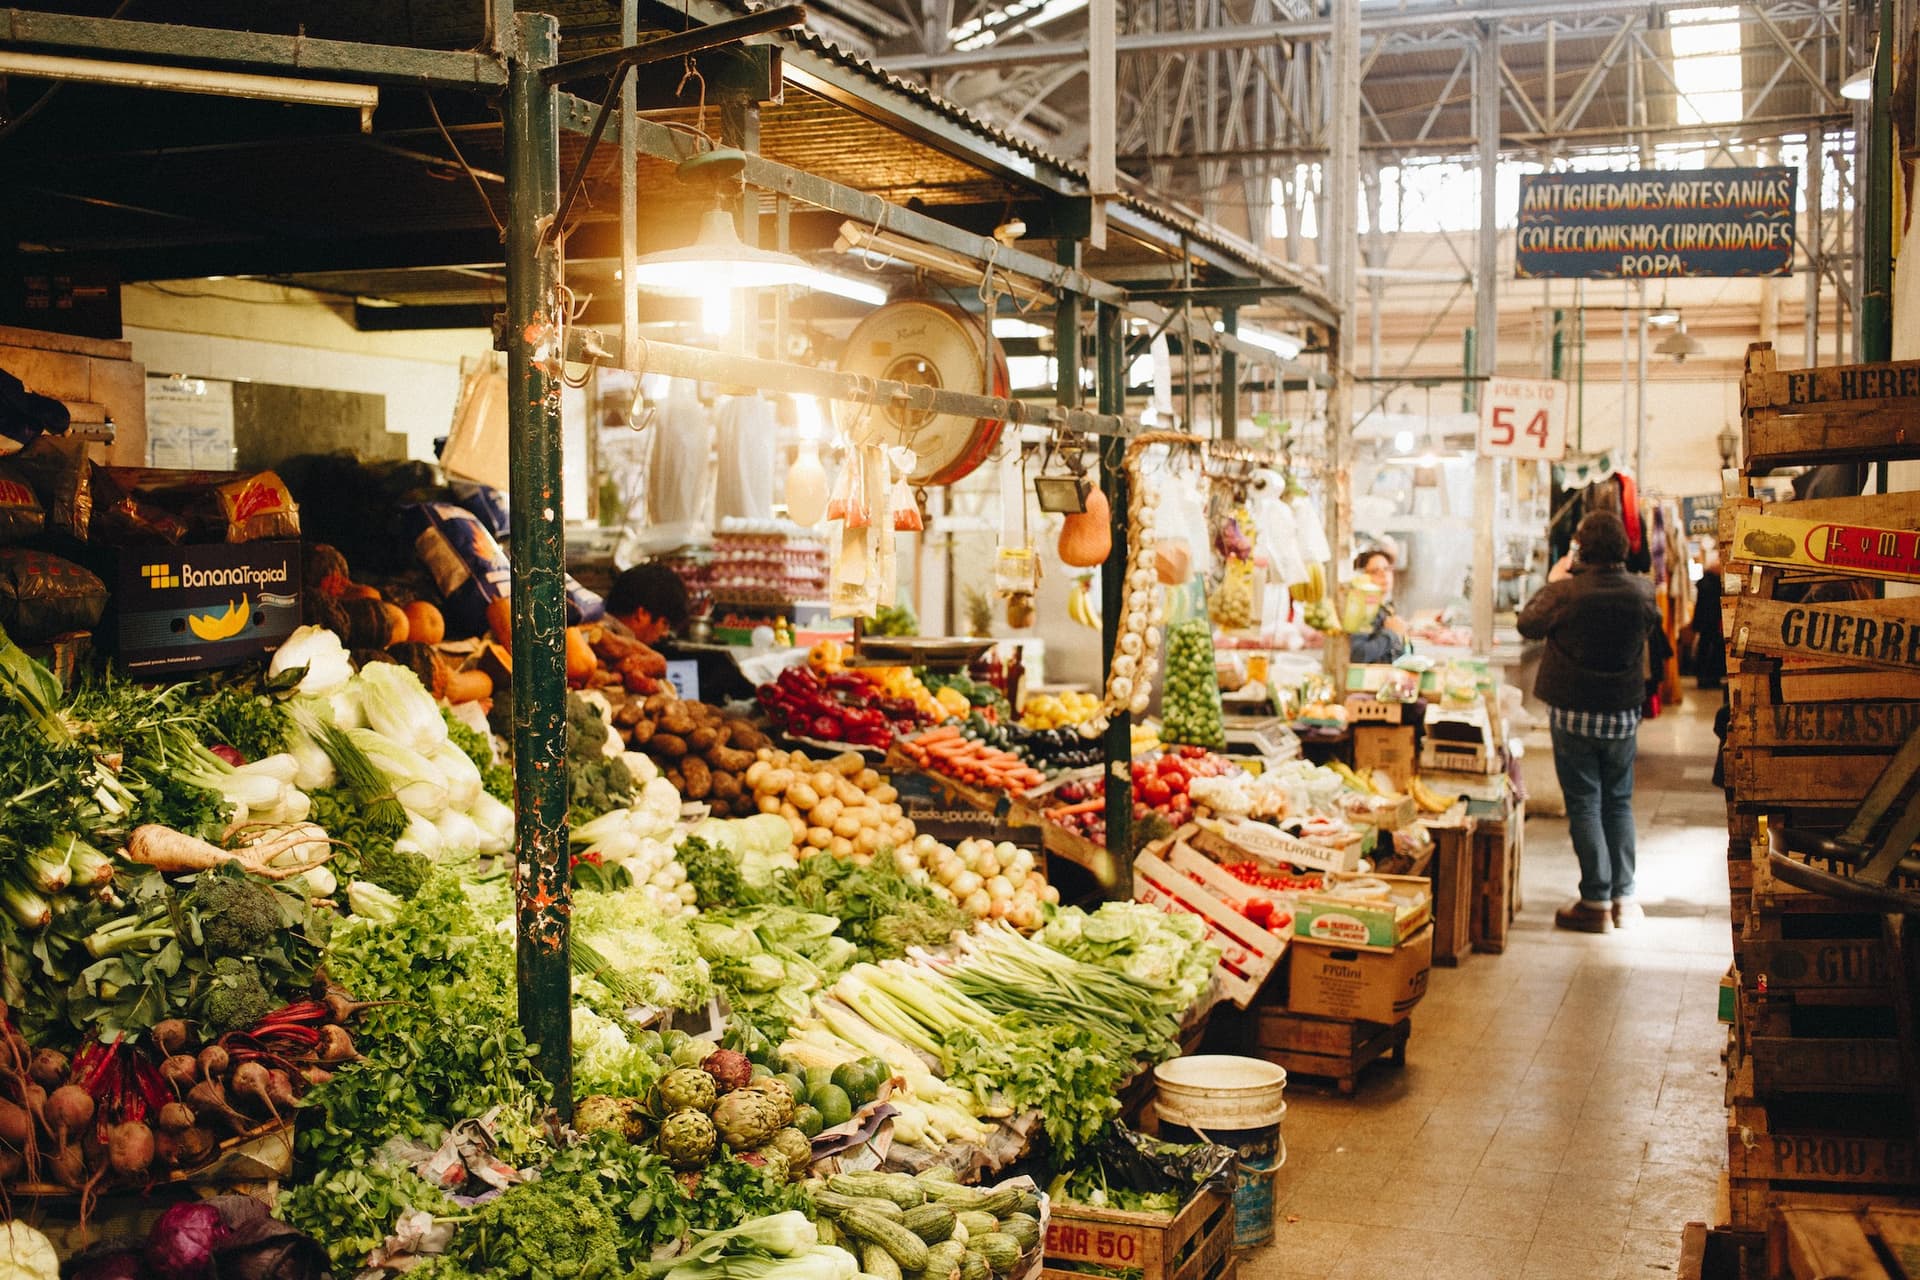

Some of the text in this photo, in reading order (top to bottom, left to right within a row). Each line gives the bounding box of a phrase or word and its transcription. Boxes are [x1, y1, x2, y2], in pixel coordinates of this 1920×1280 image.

[1621, 254, 1681, 277] ROPA
[1494, 383, 1554, 401] PUESTO
[1788, 368, 1920, 404] EL HERE
[1491, 407, 1549, 449] 54
[182, 560, 287, 590] BananaTropical
[1097, 1230, 1135, 1261] 50
